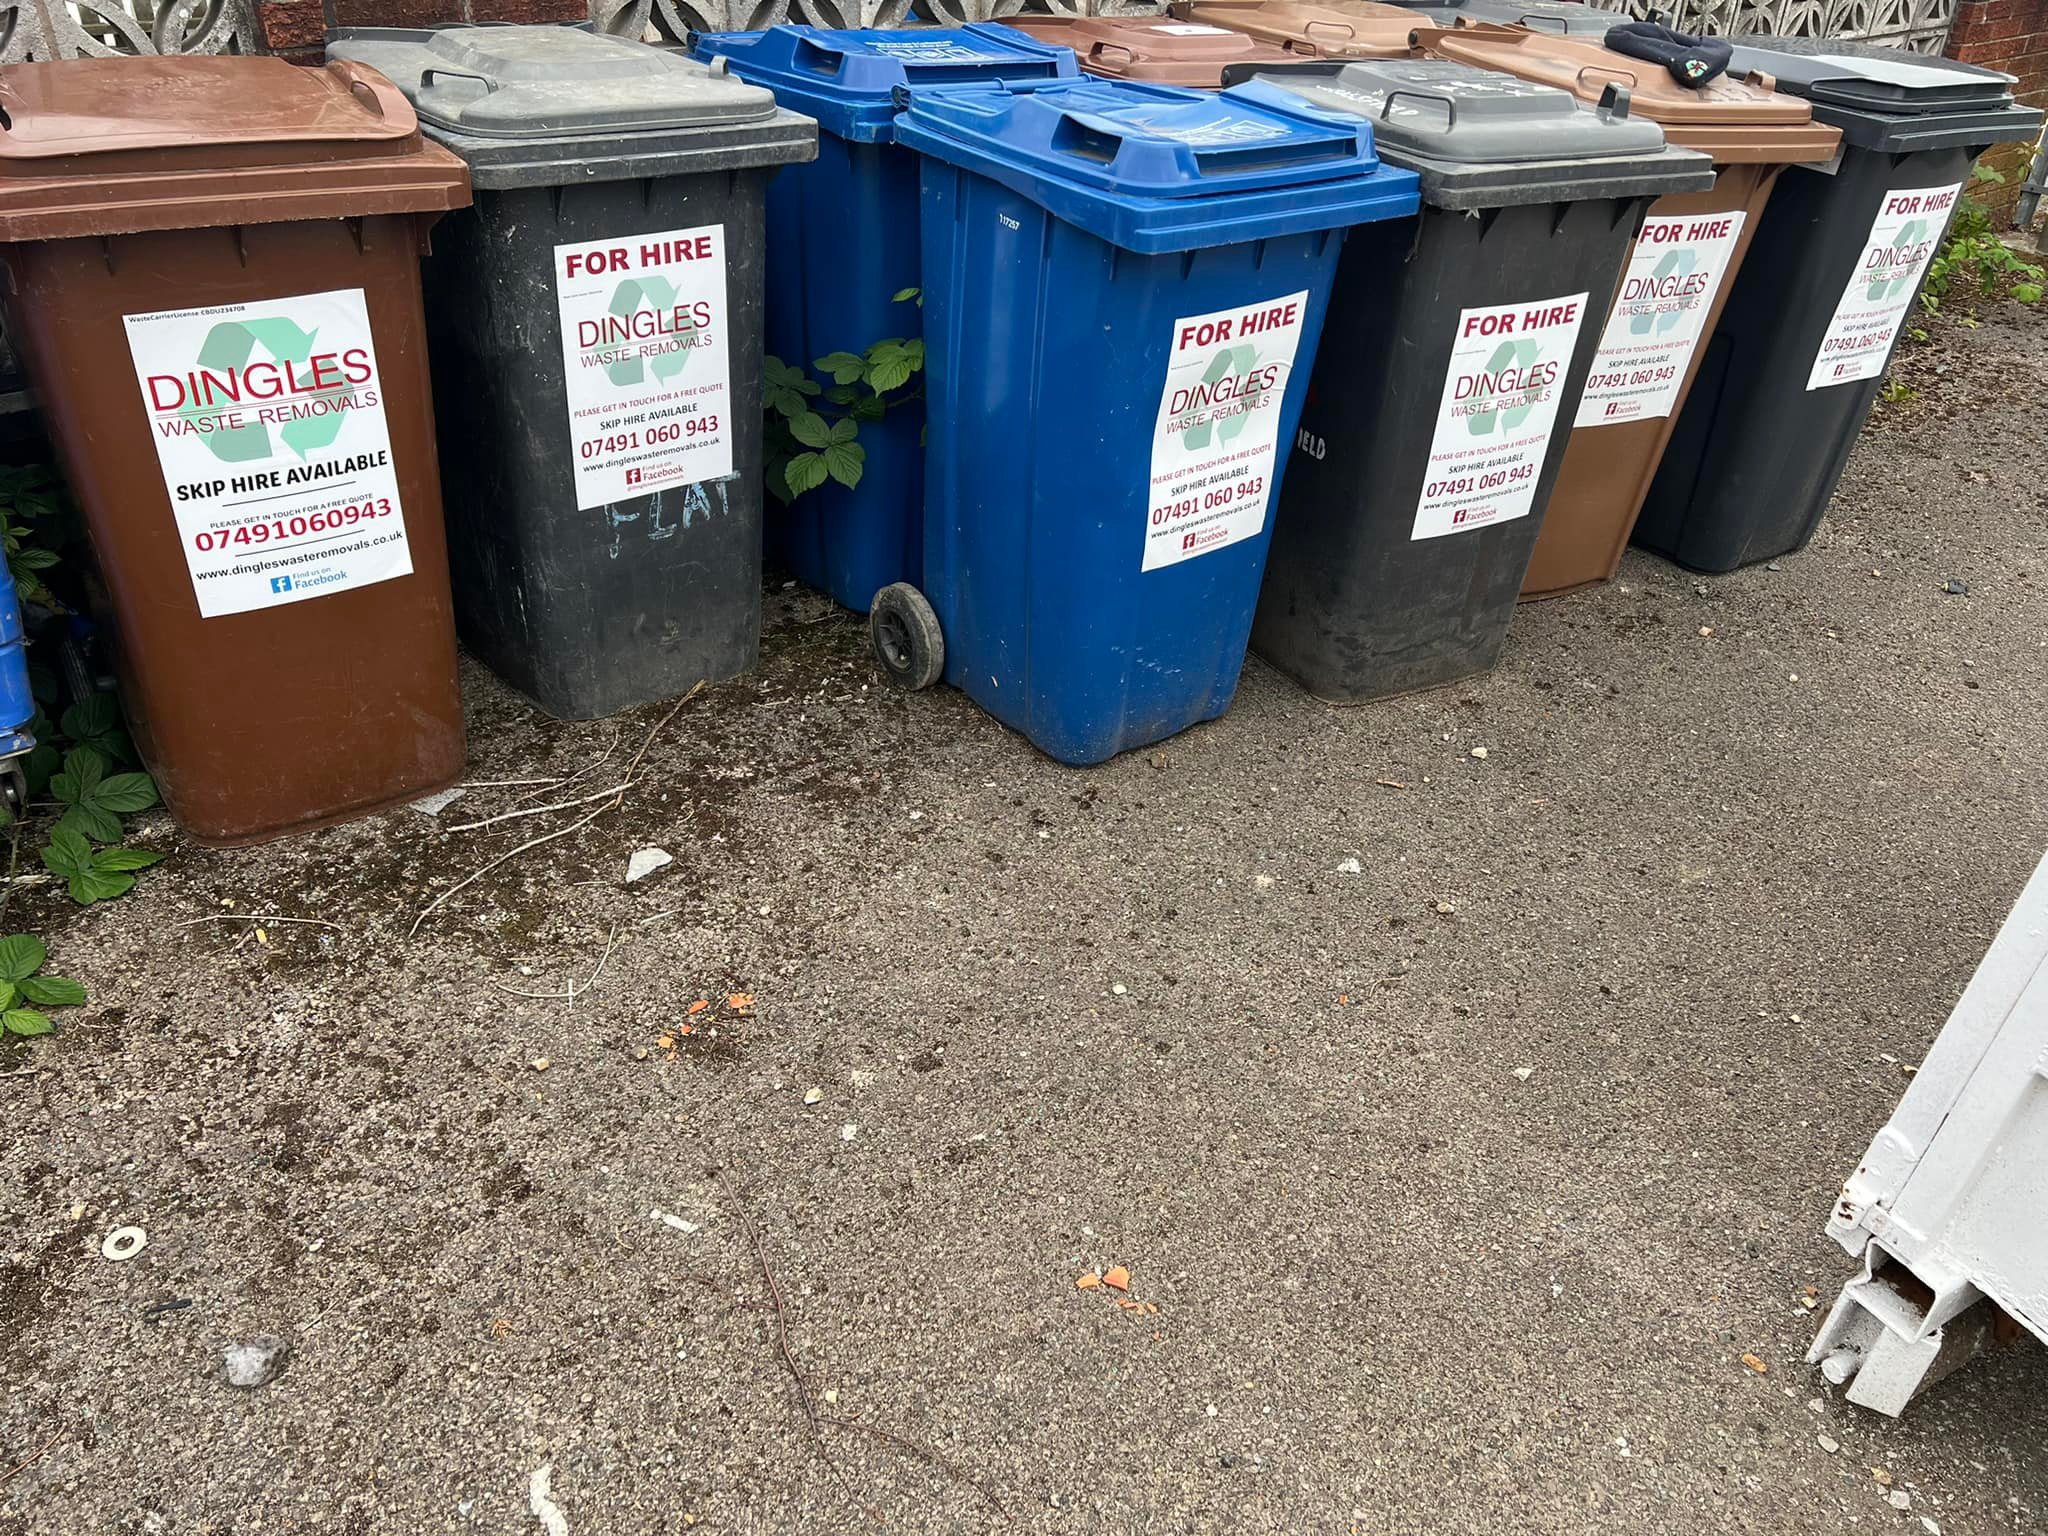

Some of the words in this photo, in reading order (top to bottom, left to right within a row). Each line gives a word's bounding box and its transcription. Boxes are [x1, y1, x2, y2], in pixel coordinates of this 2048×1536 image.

[1885, 196, 1921, 216] FOR
[1922, 190, 1955, 213] HIRE
[1639, 224, 1683, 244] FOR
[1686, 219, 1732, 241] HIRE
[566, 247, 631, 279] FOR
[640, 236, 713, 268] HIRE
[1866, 240, 1931, 269] DINGLES
[1623, 272, 1709, 300] DINGLES
[578, 301, 712, 348] DINGLES
[1463, 313, 1516, 338] FOR
[1522, 303, 1578, 331] HIRE
[1618, 304, 1652, 317] WASTE
[1655, 299, 1701, 314] REMOVALS
[1179, 319, 1233, 351] FOR
[1239, 302, 1298, 337] HIRE
[1824, 337, 1858, 353] 07491
[1858, 332, 1877, 348] 060
[580, 348, 631, 368] WASTE
[639, 334, 713, 358] REMOVALS
[1608, 360, 1624, 369] SKIP
[1623, 358, 1639, 367] HIRE
[1639, 354, 1670, 366] AVAILABLE
[147, 348, 372, 411] DINGLES
[1169, 365, 1278, 416] DINGLES
[1454, 361, 1558, 401] DINGLES
[1587, 372, 1628, 389] 07491
[1630, 369, 1653, 385] 060
[1654, 366, 1676, 382] 943
[158, 412, 245, 437] WASTE
[259, 391, 378, 425] REMOVALS
[574, 406, 601, 419] PLEASE
[602, 403, 617, 414] GET
[618, 401, 628, 410] IN
[629, 397, 656, 408] TOUCH
[657, 393, 673, 404] FOR
[673, 391, 681, 400] A
[681, 388, 698, 398] FREE
[699, 383, 724, 394] QUOTE
[600, 419, 621, 431] SKIP
[623, 414, 647, 427] HIRE
[648, 403, 699, 421] AVAILABLE
[1166, 413, 1206, 434] WASTE
[1211, 395, 1270, 422] REMOVALS
[1451, 401, 1490, 418] WASTE
[1495, 390, 1551, 411] REMOVALS
[581, 431, 640, 460] 07491
[646, 423, 681, 446] 060
[685, 415, 720, 437] 943
[1431, 452, 1454, 462] PLEASE
[1454, 450, 1467, 459] GET
[1468, 448, 1476, 457] IN
[1476, 445, 1497, 455] TOUCH
[1498, 443, 1510, 451] FOR
[1510, 441, 1515, 449] A
[1515, 438, 1528, 447] FREE
[1528, 434, 1546, 444] QUOTE
[583, 437, 721, 473] www.dingleswasteremovals.co.uk
[1152, 473, 1174, 485] PLEASE
[1174, 468, 1187, 479] GET
[1187, 466, 1195, 475] IN
[1195, 461, 1218, 472] TOUCH
[1217, 457, 1230, 466] FOR
[1230, 454, 1237, 462] A
[1236, 449, 1251, 460] FREE
[1251, 443, 1271, 456] QUOTE
[1448, 463, 1467, 475] SKIP
[1467, 460, 1486, 472] HIRE
[1487, 452, 1525, 469] AVAILABLE
[176, 480, 226, 501] SKIP
[231, 471, 282, 494] HIRE
[286, 450, 388, 485] AVAILABLE
[643, 465, 684, 481] Facebook
[1171, 484, 1188, 497] SKIP
[1189, 477, 1208, 491] HIRE
[1208, 465, 1249, 486] AVAILABLE
[1426, 477, 1475, 498] 07491
[1479, 470, 1507, 490] 060
[1508, 463, 1534, 483] 943
[210, 518, 242, 529] PLEASE
[244, 515, 261, 524] GET
[272, 508, 301, 520] TOUCH
[302, 505, 320, 514] FOR
[327, 498, 348, 509] FREE
[348, 493, 373, 504] QUOTE
[1152, 497, 1200, 526] 07491
[1204, 486, 1233, 510] 060
[1237, 476, 1263, 500] 943
[1467, 508, 1497, 520] Facebook
[194, 498, 392, 552] 07491060943
[1196, 528, 1228, 545] Facebook
[196, 530, 403, 581] www.dingleswasteremovals.co.uk
[292, 570, 310, 580] Find
[311, 568, 324, 578] us
[294, 570, 348, 589] Facebook
